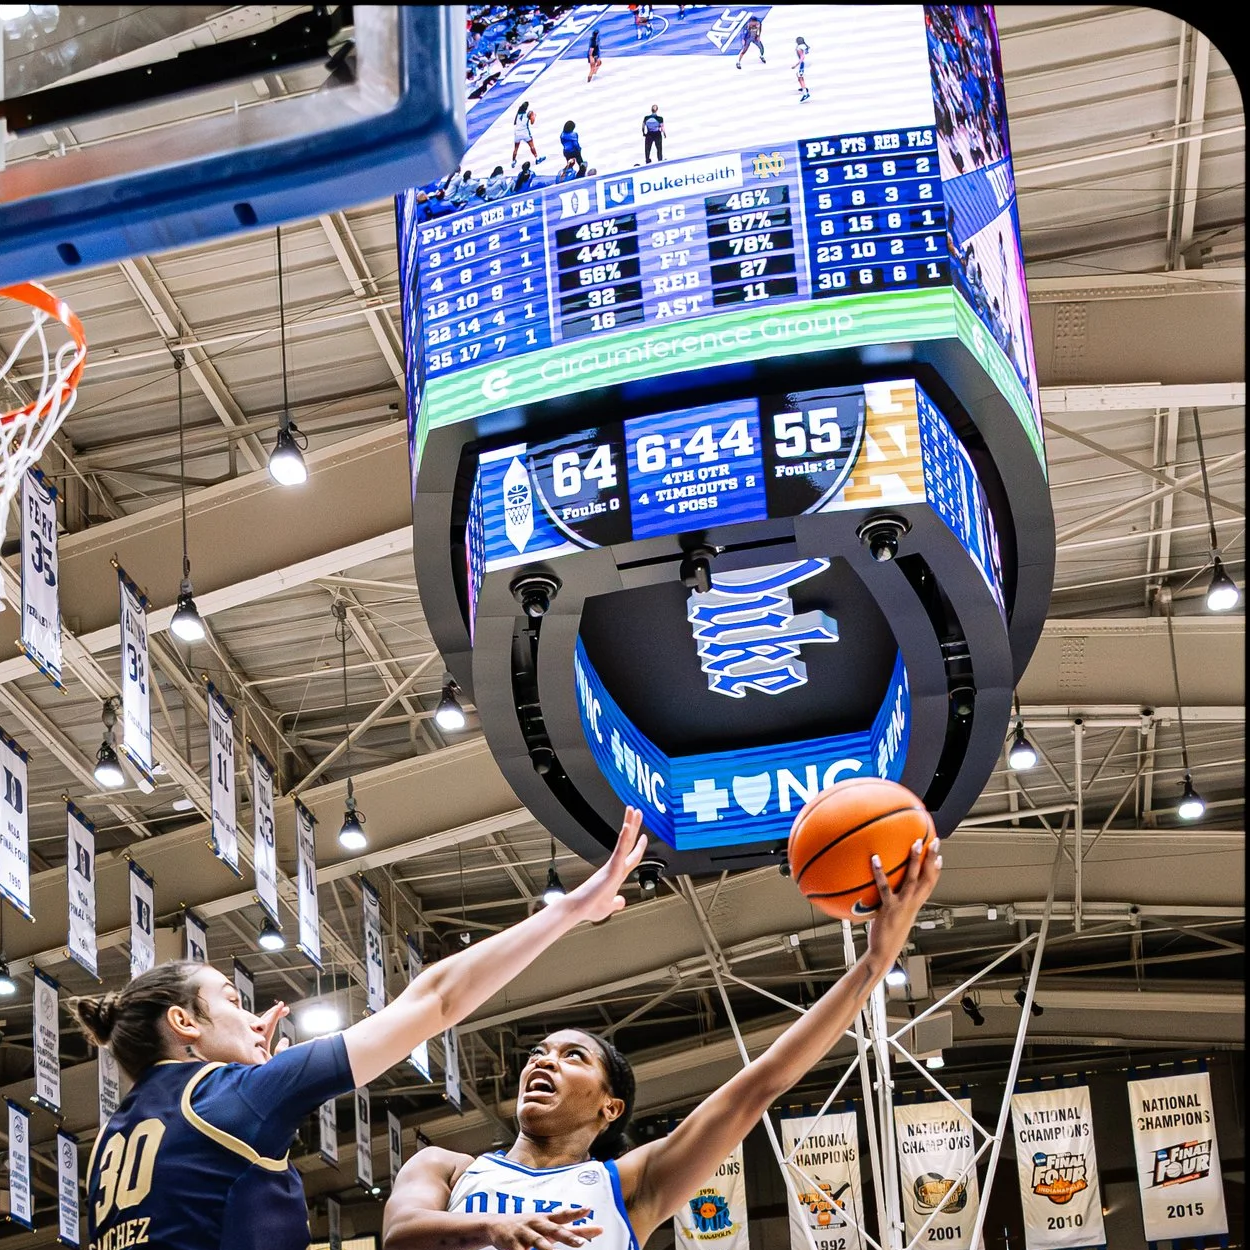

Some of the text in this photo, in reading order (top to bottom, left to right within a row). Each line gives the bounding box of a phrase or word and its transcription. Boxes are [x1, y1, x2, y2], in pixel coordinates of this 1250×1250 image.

[806, 130, 933, 158] PL PTS REB FLS
[640, 166, 735, 194] DukeHealth
[815, 158, 930, 183] 3 13 8 2
[818, 184, 932, 209] 5 8 3 2
[422, 199, 535, 244] PL PTS REB FLS
[576, 189, 770, 241] 45% FG 46%
[821, 210, 934, 235] 8 15 6 1
[429, 227, 531, 268] 3 10 2 1
[577, 211, 771, 263] 44% 3PT 67%
[817, 236, 937, 262] 23 10 2 1
[430, 252, 532, 292] 4 8 3 1
[580, 234, 773, 285] 56% FT 78%
[588, 258, 767, 308] 32 REB 27
[819, 263, 940, 289] 30 6 6 1
[427, 278, 534, 319] 12 10 9 1
[591, 283, 769, 331] 16 AST 11
[428, 303, 535, 345] 22 14 4 1
[429, 329, 537, 370] 35 17 7 1
[540, 310, 853, 382] Circumference Group
[636, 419, 754, 473] 6:44
[774, 407, 841, 459] 55
[552, 444, 617, 498] 64
[661, 464, 730, 486] 4TH QTR
[775, 459, 835, 478] Fouls: 2
[638, 476, 755, 505] 4 TIMEOUTS 2
[562, 498, 619, 520] Fouls: 0
[677, 497, 718, 513] POSS
[31, 529, 56, 587] 35
[217, 752, 229, 793] 11
[636, 754, 666, 814] NC
[1024, 1107, 1080, 1125] NATIONAL
[1143, 1094, 1201, 1112] NATIONAL
[908, 1119, 963, 1137] NATIONAL
[1020, 1124, 1089, 1143] CHAMPIONS
[1137, 1111, 1210, 1130] CHAMPIONS
[794, 1133, 847, 1149] NATIONAL
[902, 1135, 970, 1154] CHAMPIONS
[1171, 1142, 1211, 1162] FINAL
[95, 1118, 166, 1227] 30
[1047, 1153, 1084, 1169] FINAL
[1033, 1165, 1087, 1188] FOUR
[1047, 1214, 1083, 1229] 2010
[1167, 1203, 1204, 1218] 2015
[928, 1226, 961, 1241] 2001
